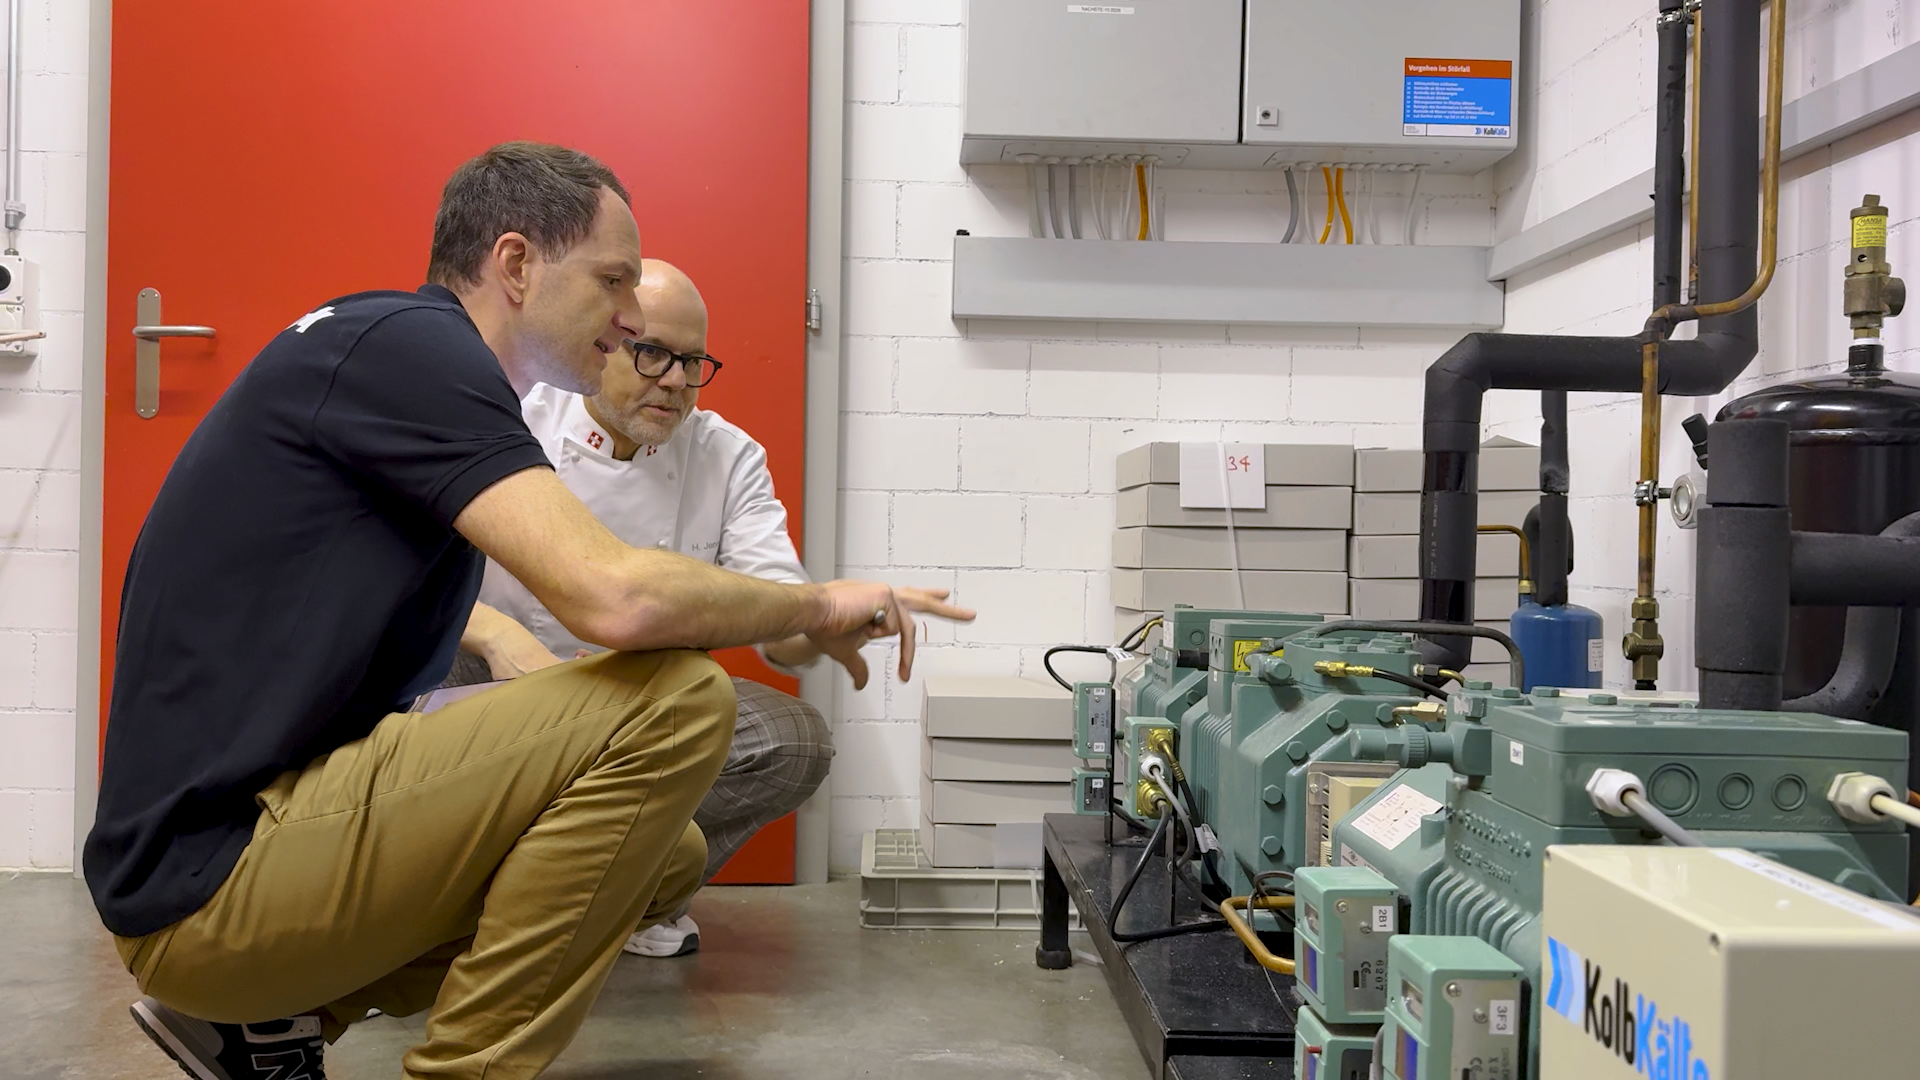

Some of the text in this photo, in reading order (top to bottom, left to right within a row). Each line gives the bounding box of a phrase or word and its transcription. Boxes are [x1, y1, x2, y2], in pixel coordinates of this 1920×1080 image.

[1447, 65, 1471, 73] Störfall
[1227, 455, 1251, 473] 34
[691, 543, 701, 551] H.
[1378, 908, 1388, 929] 2B1
[1375, 959, 1385, 992] 6207
[1495, 1005, 1508, 1031] 3F3
